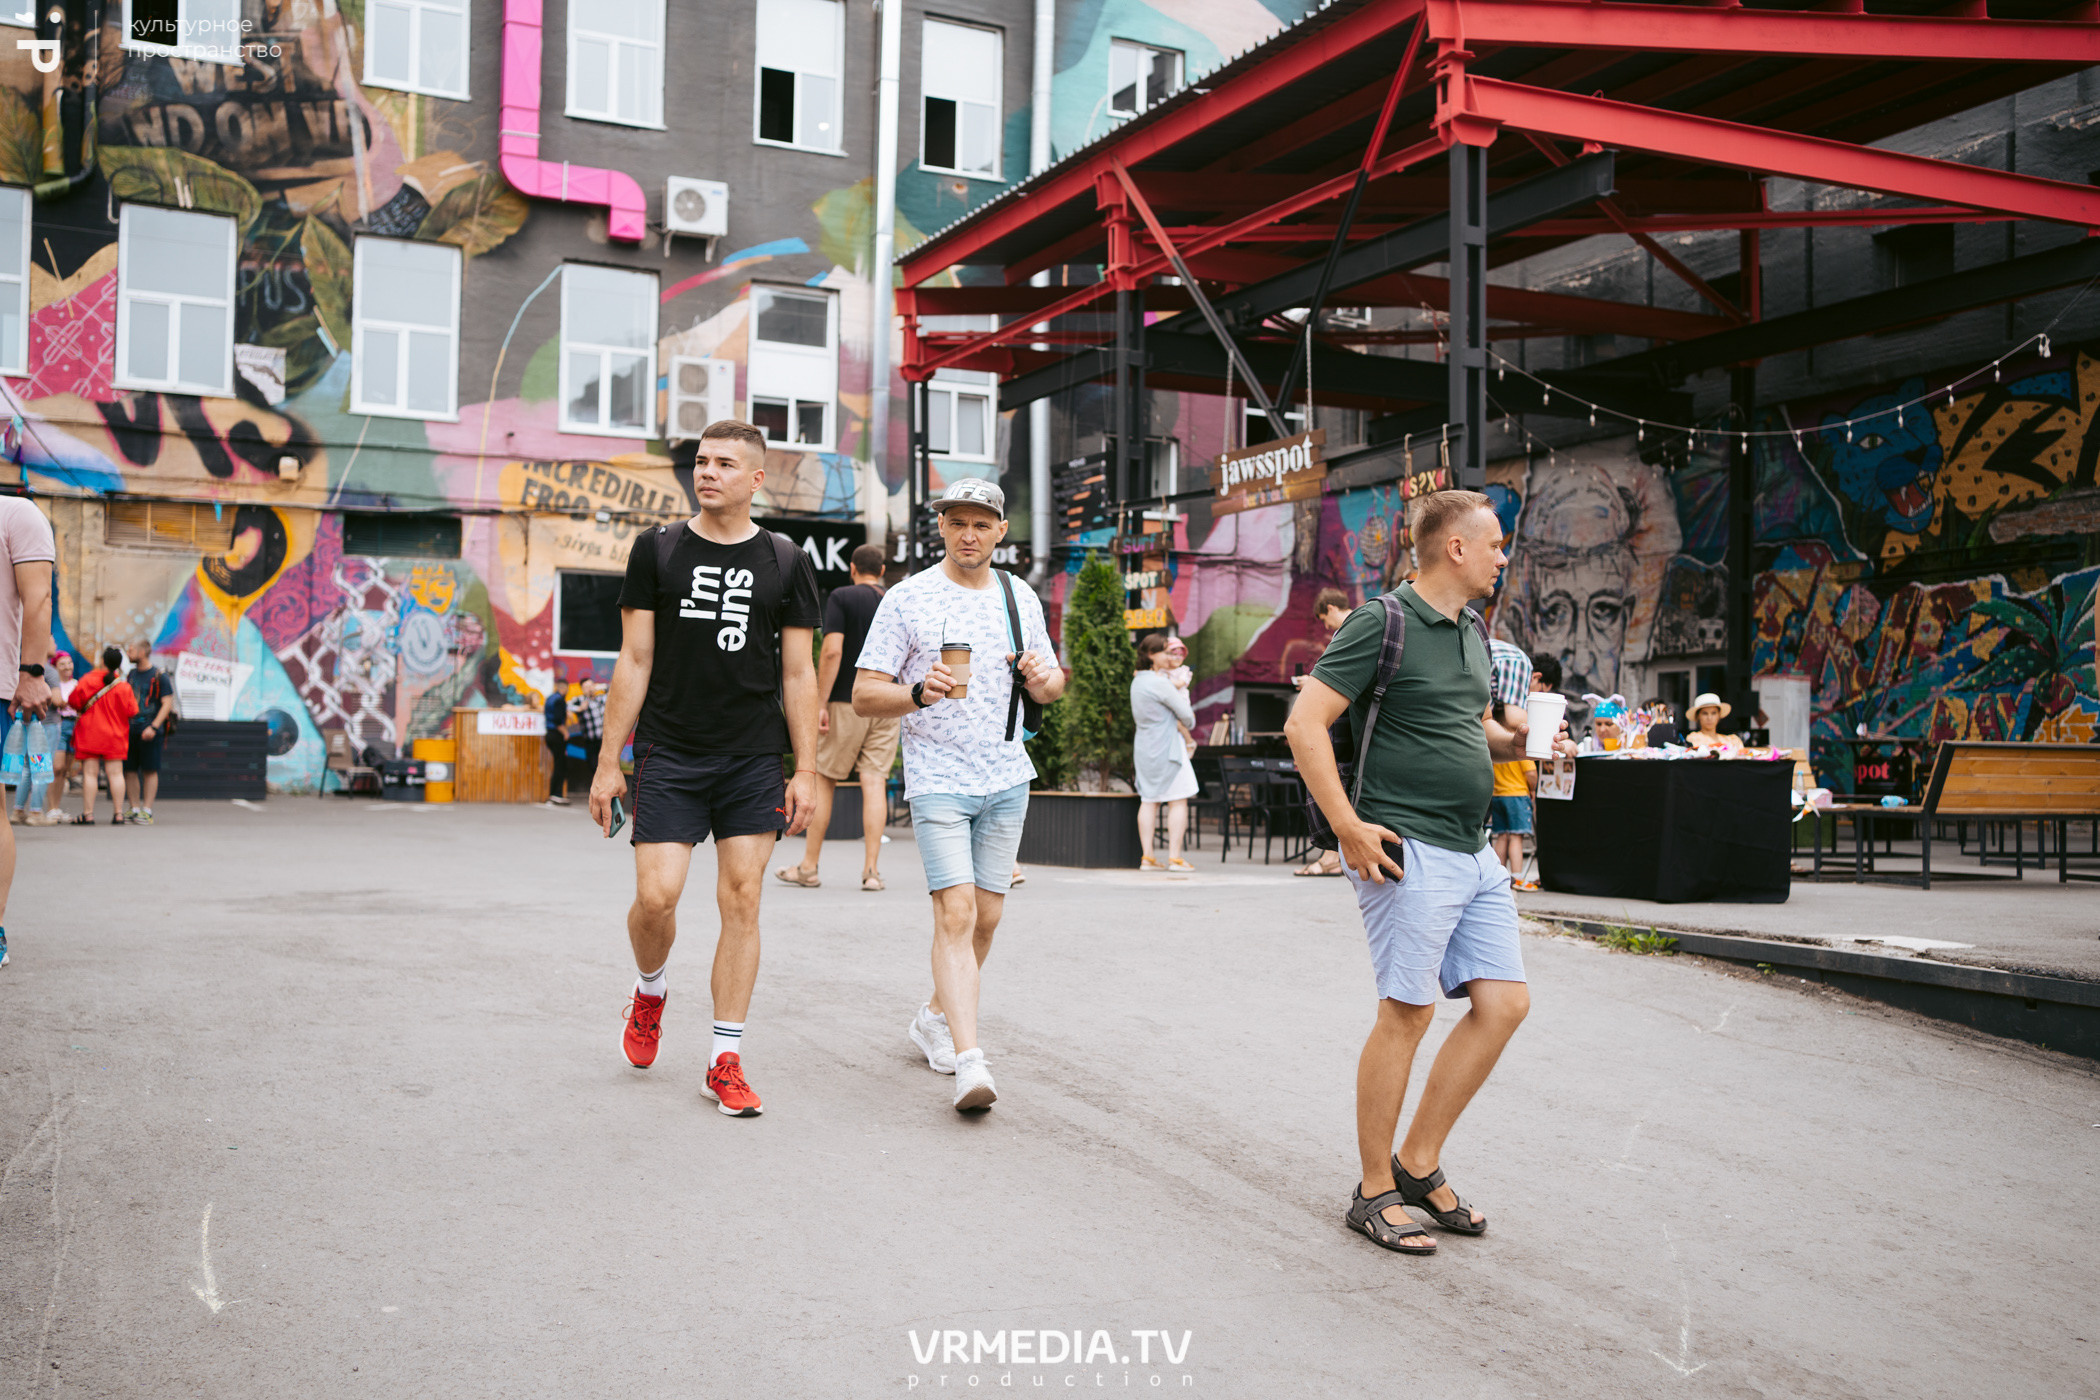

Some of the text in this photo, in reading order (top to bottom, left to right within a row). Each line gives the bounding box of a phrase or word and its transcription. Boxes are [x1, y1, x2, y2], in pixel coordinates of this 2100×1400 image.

[522, 460, 677, 521] INCREDIBLE
[943, 483, 991, 501] UFC
[1220, 434, 1314, 497] jawsspot
[679, 565, 722, 620] I'm
[717, 567, 754, 652] sure
[1123, 571, 1159, 591] SPOT
